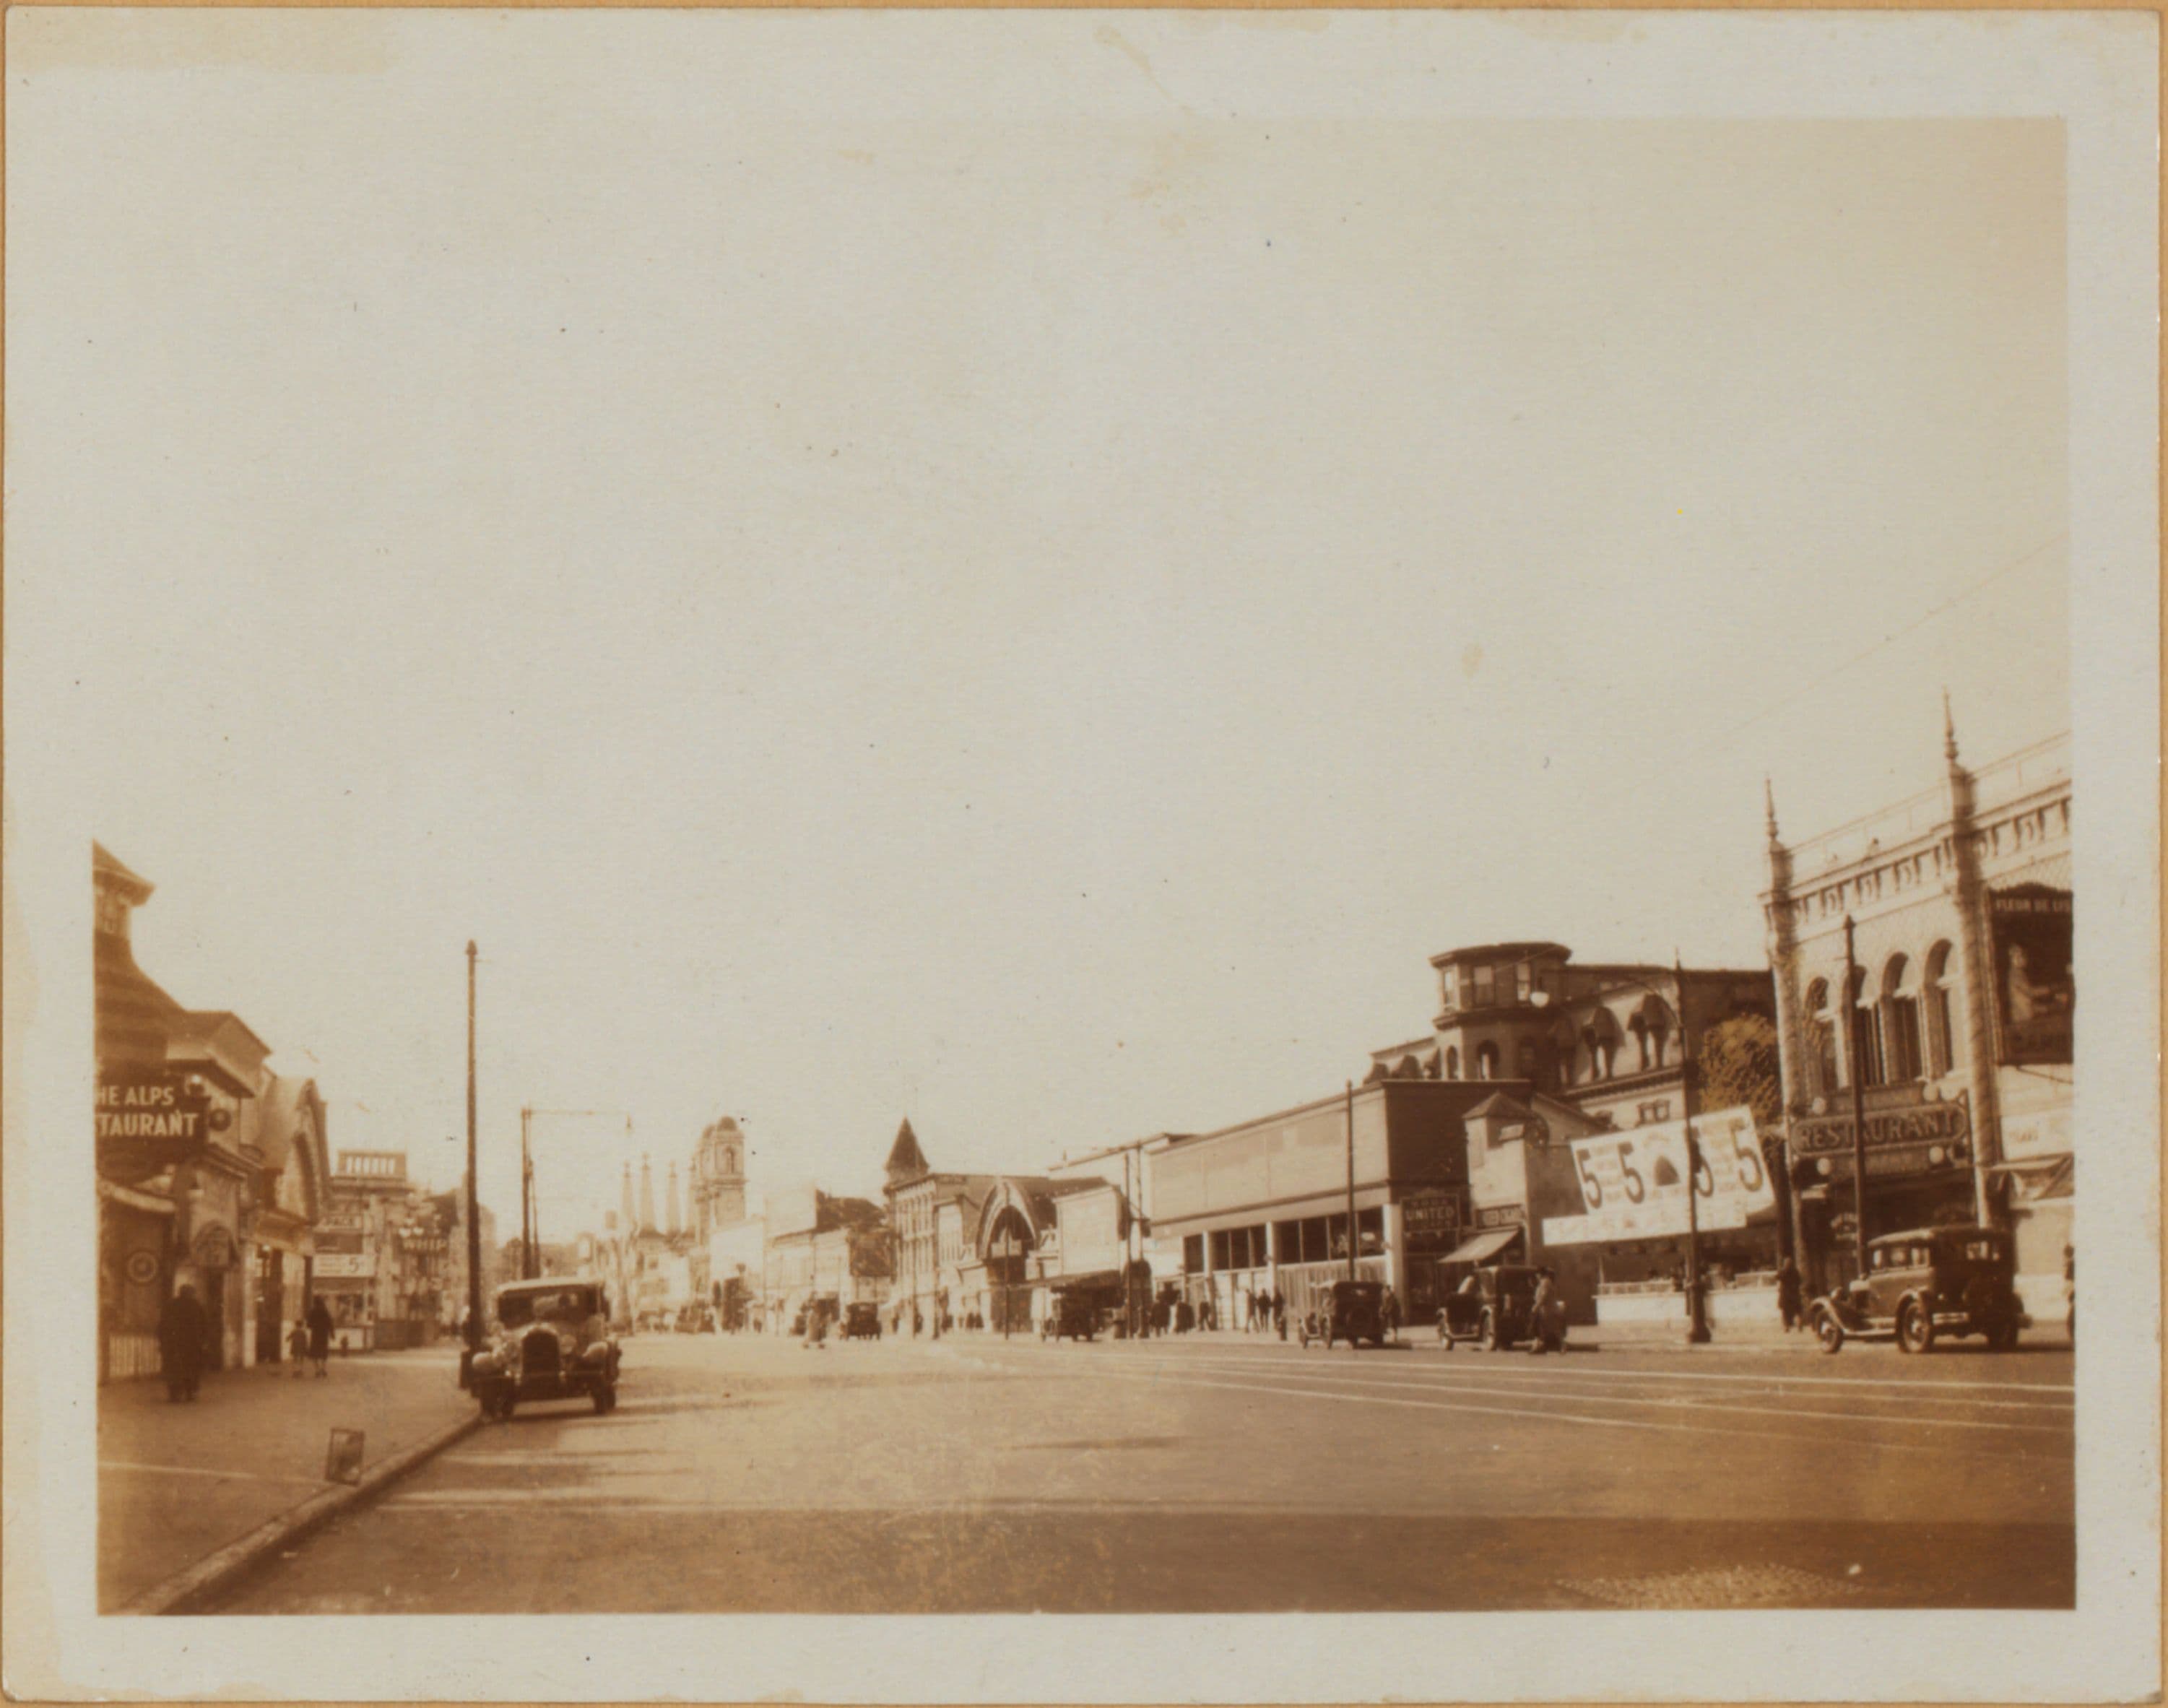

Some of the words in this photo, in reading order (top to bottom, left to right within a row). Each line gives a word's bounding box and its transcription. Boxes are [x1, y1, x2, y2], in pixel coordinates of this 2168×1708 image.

[124, 1085, 175, 1106] ALPS
[95, 1111, 199, 1137] TAURANT
[1617, 1142, 1644, 1204] 5
[1728, 1117, 1763, 1192] 5
[1575, 1148, 1603, 1209] 5
[1405, 1205, 1455, 1221] UNITED
